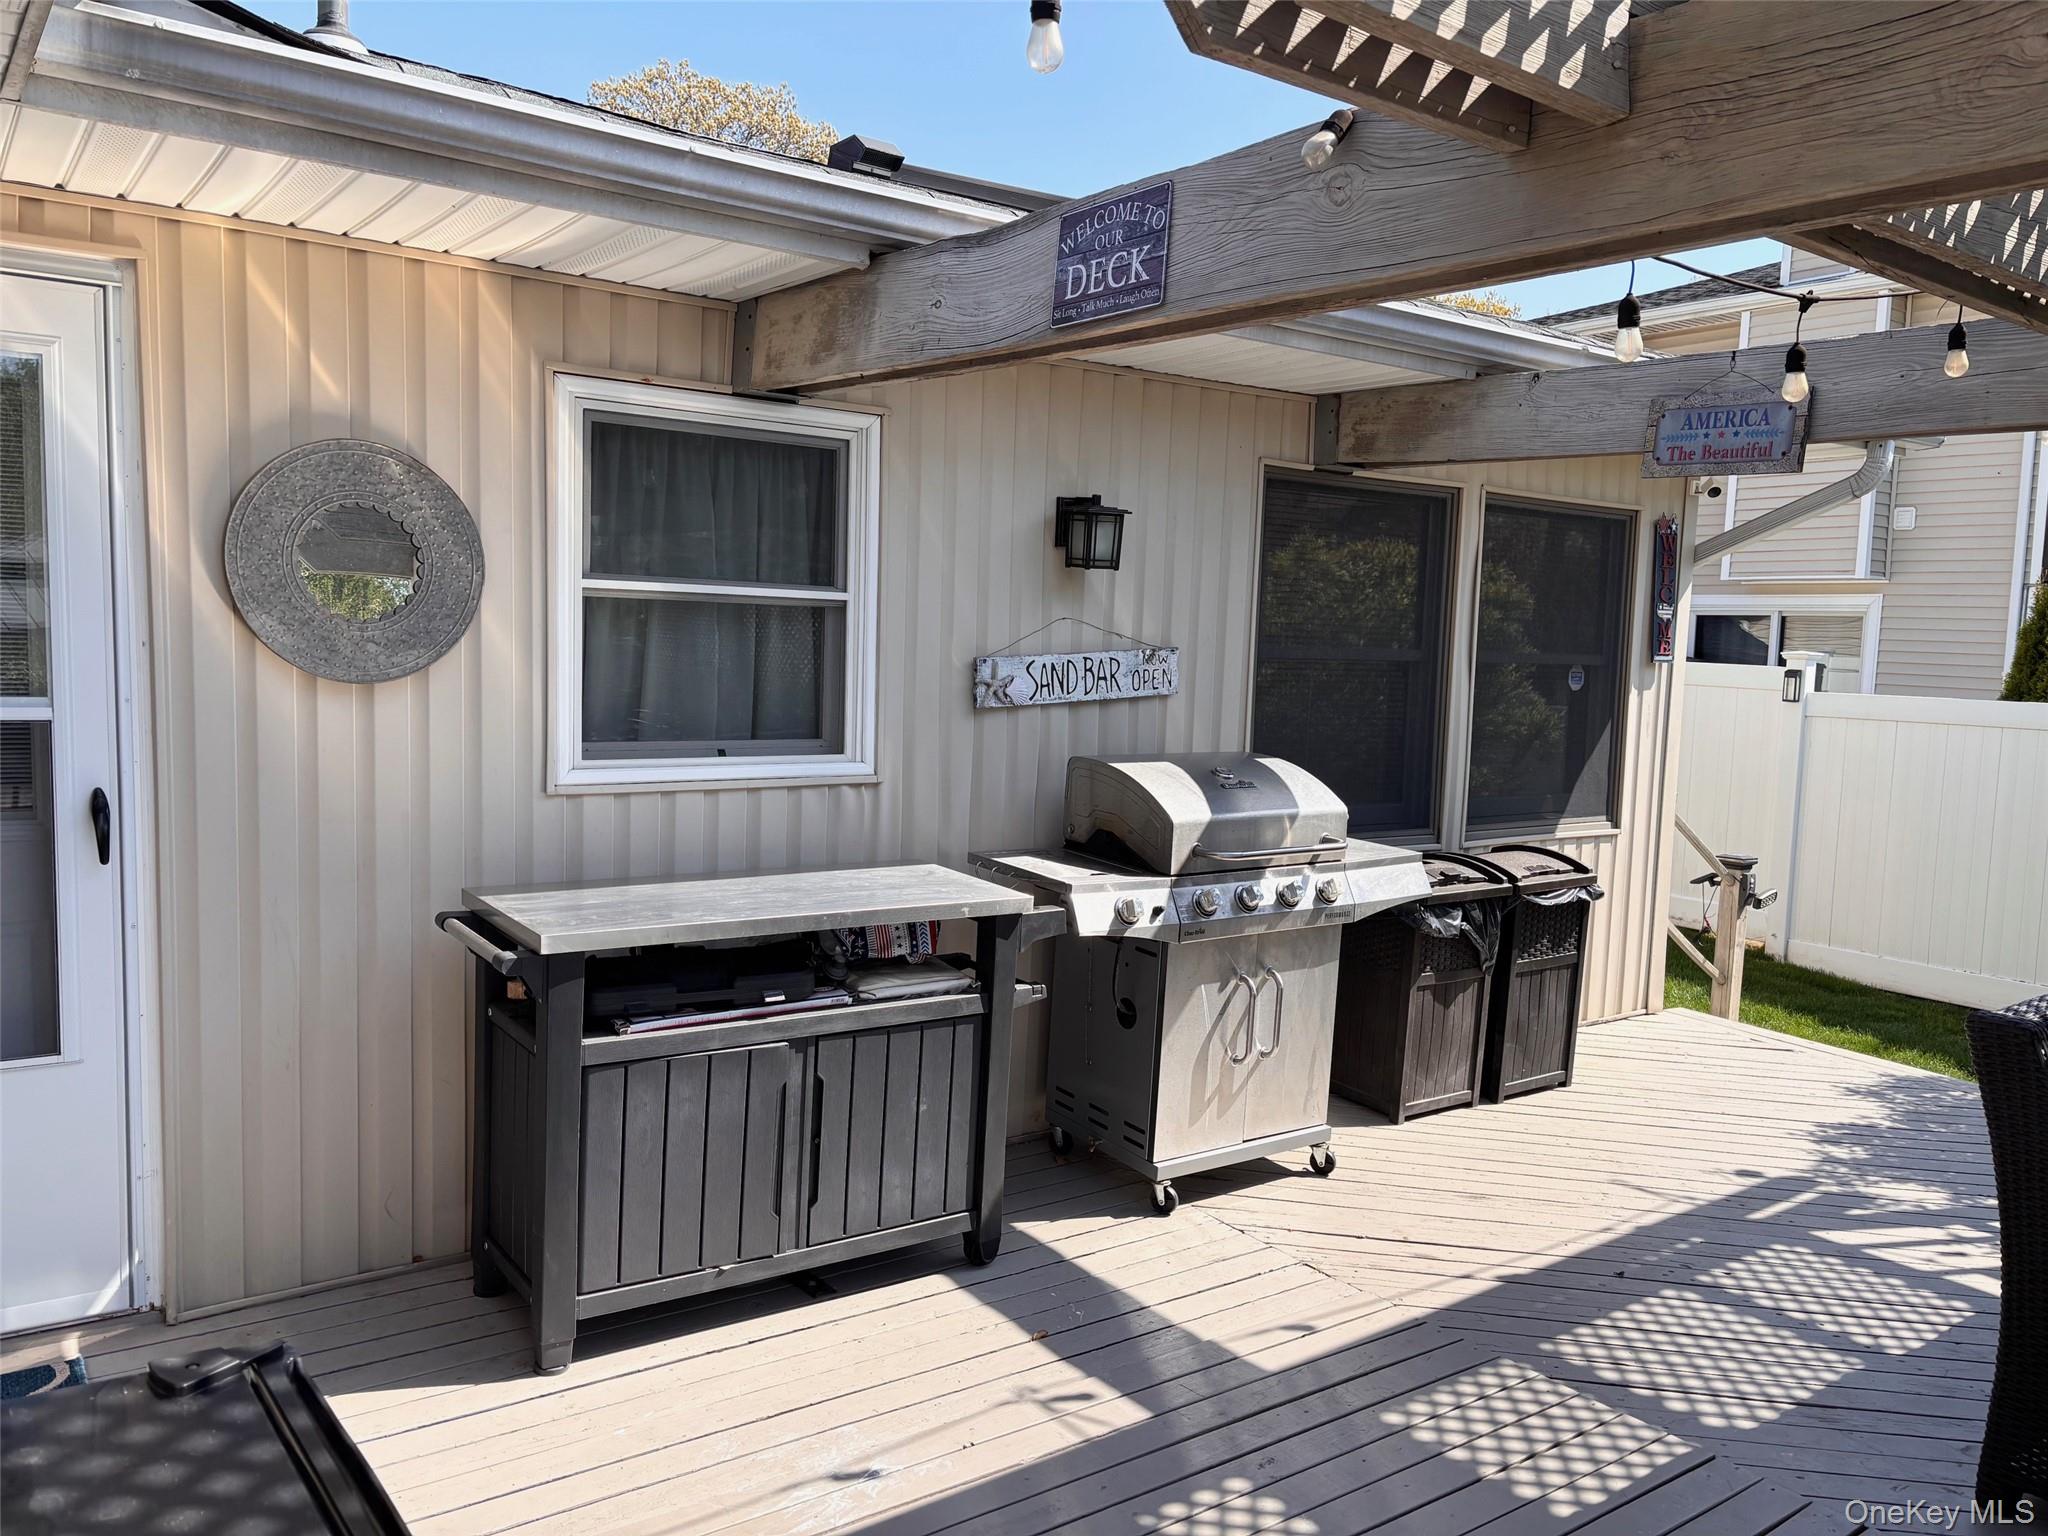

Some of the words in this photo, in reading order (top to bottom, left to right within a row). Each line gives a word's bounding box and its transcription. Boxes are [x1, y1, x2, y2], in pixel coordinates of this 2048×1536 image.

[1061, 202, 1142, 254] WELCOME
[1144, 204, 1166, 230] TO
[1095, 229, 1123, 250] OUR
[1065, 244, 1151, 300] DECK
[1082, 302, 1095, 312] Talk
[1096, 297, 1115, 309] Much
[1119, 291, 1140, 304] Laugh
[1680, 407, 1770, 431] AMERICA
[1667, 445, 1696, 462] The
[1702, 440, 1774, 461] Beautiful
[1657, 534, 1677, 657] WELCME
[1132, 668, 1172, 691] OPEN
